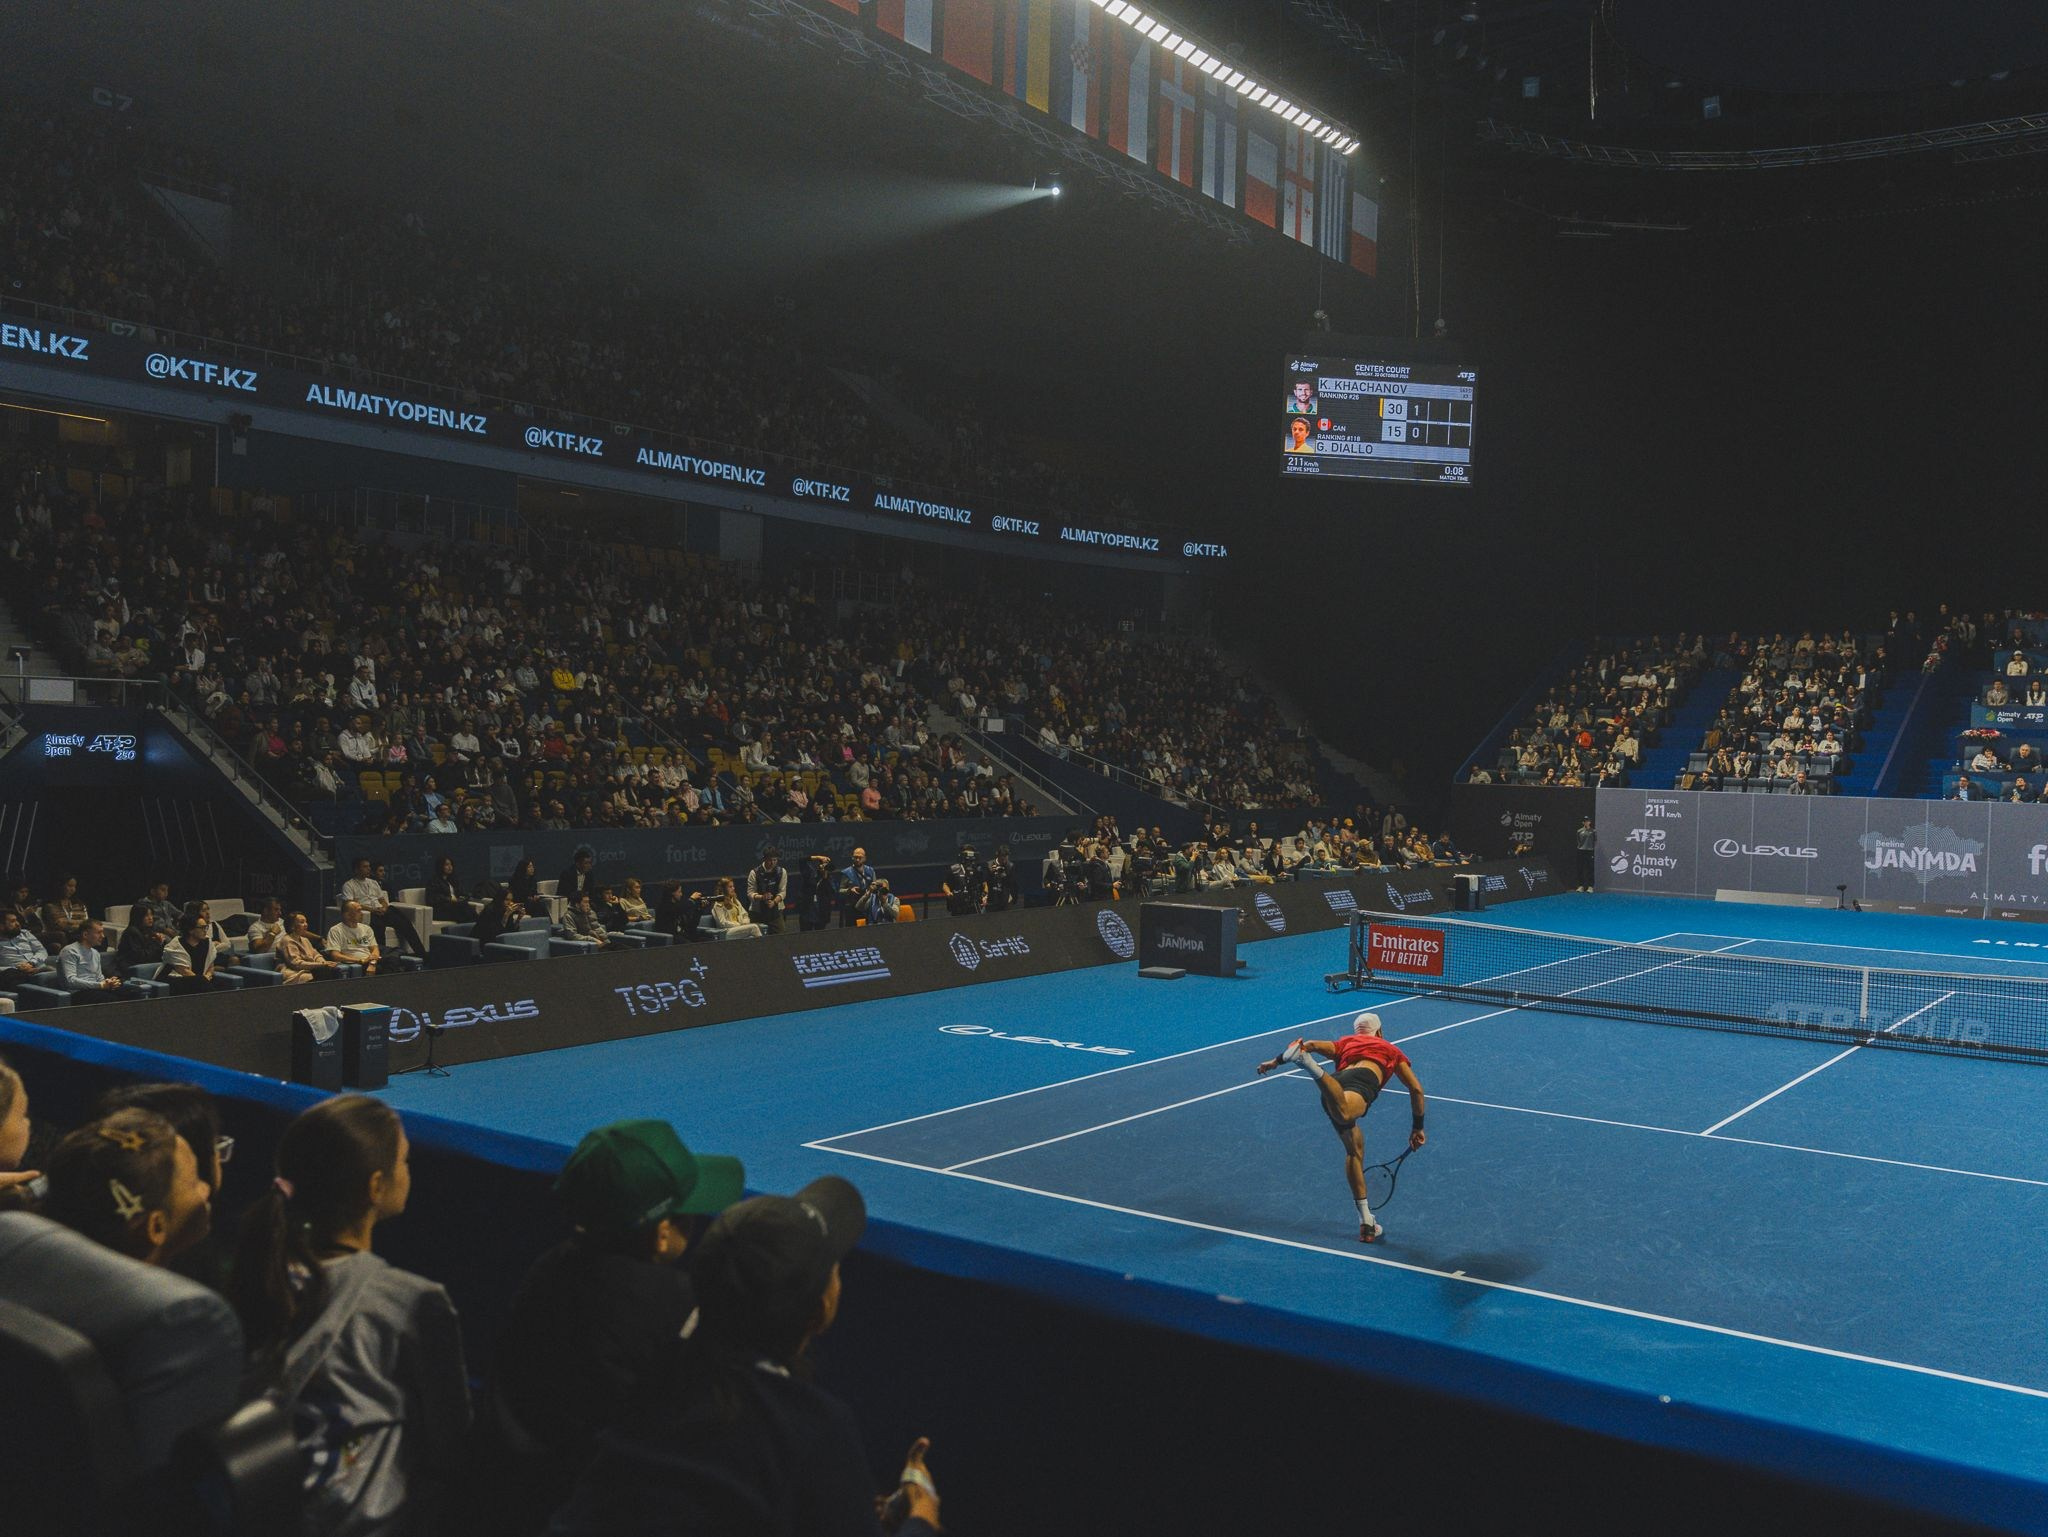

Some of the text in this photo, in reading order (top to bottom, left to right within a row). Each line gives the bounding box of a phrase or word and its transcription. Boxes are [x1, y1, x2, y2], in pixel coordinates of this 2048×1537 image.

[1, 323, 88, 361] EN.KZ
[145, 353, 257, 392] @KTF.KZ
[1355, 364, 1410, 374] CENTER COURT
[1320, 380, 1407, 394] K. KHACHANOV
[1319, 392, 1347, 400] RANKING
[306, 383, 487, 434] ALMATYOPEN.KZ
[1388, 403, 1419, 416] 30 1
[1388, 426, 1419, 438] 15 0
[525, 426, 603, 456] @KTF.KZ
[1316, 441, 1373, 454] G. DIALLO
[636, 447, 765, 486] ALMATYOPEN.KZ
[1288, 457, 1303, 466] 211
[1445, 466, 1464, 475] 0:08
[793, 477, 850, 502] @KTF.KZ
[874, 494, 971, 524] ALMATYOPEN.KZ
[992, 515, 1039, 535] @KTF.KZ
[1060, 527, 1159, 551] ALMATYOPEN.KZ
[1997, 711, 2020, 719] Almaty
[45, 734, 136, 752] Almaty ATP
[1645, 804, 1665, 817] 211
[1514, 813, 1542, 823] Almaty
[1514, 820, 1533, 829] Open
[1509, 831, 1534, 841] ATP
[1625, 829, 1667, 842] ATP
[1648, 843, 1666, 851] 250
[1876, 840, 1905, 849] Beeline
[665, 844, 707, 863] forte
[1741, 845, 1818, 859] LEXUS
[1633, 854, 1678, 869] Almaty
[1864, 847, 1977, 872] JANYMDA
[2028, 844, 2048, 875] f
[1632, 865, 1663, 878] Open
[1157, 936, 1205, 951] JANYMDA
[1372, 932, 1440, 953] Emirates
[1381, 951, 1429, 967] FLY BETTER
[421, 999, 540, 1029] LEXUS
